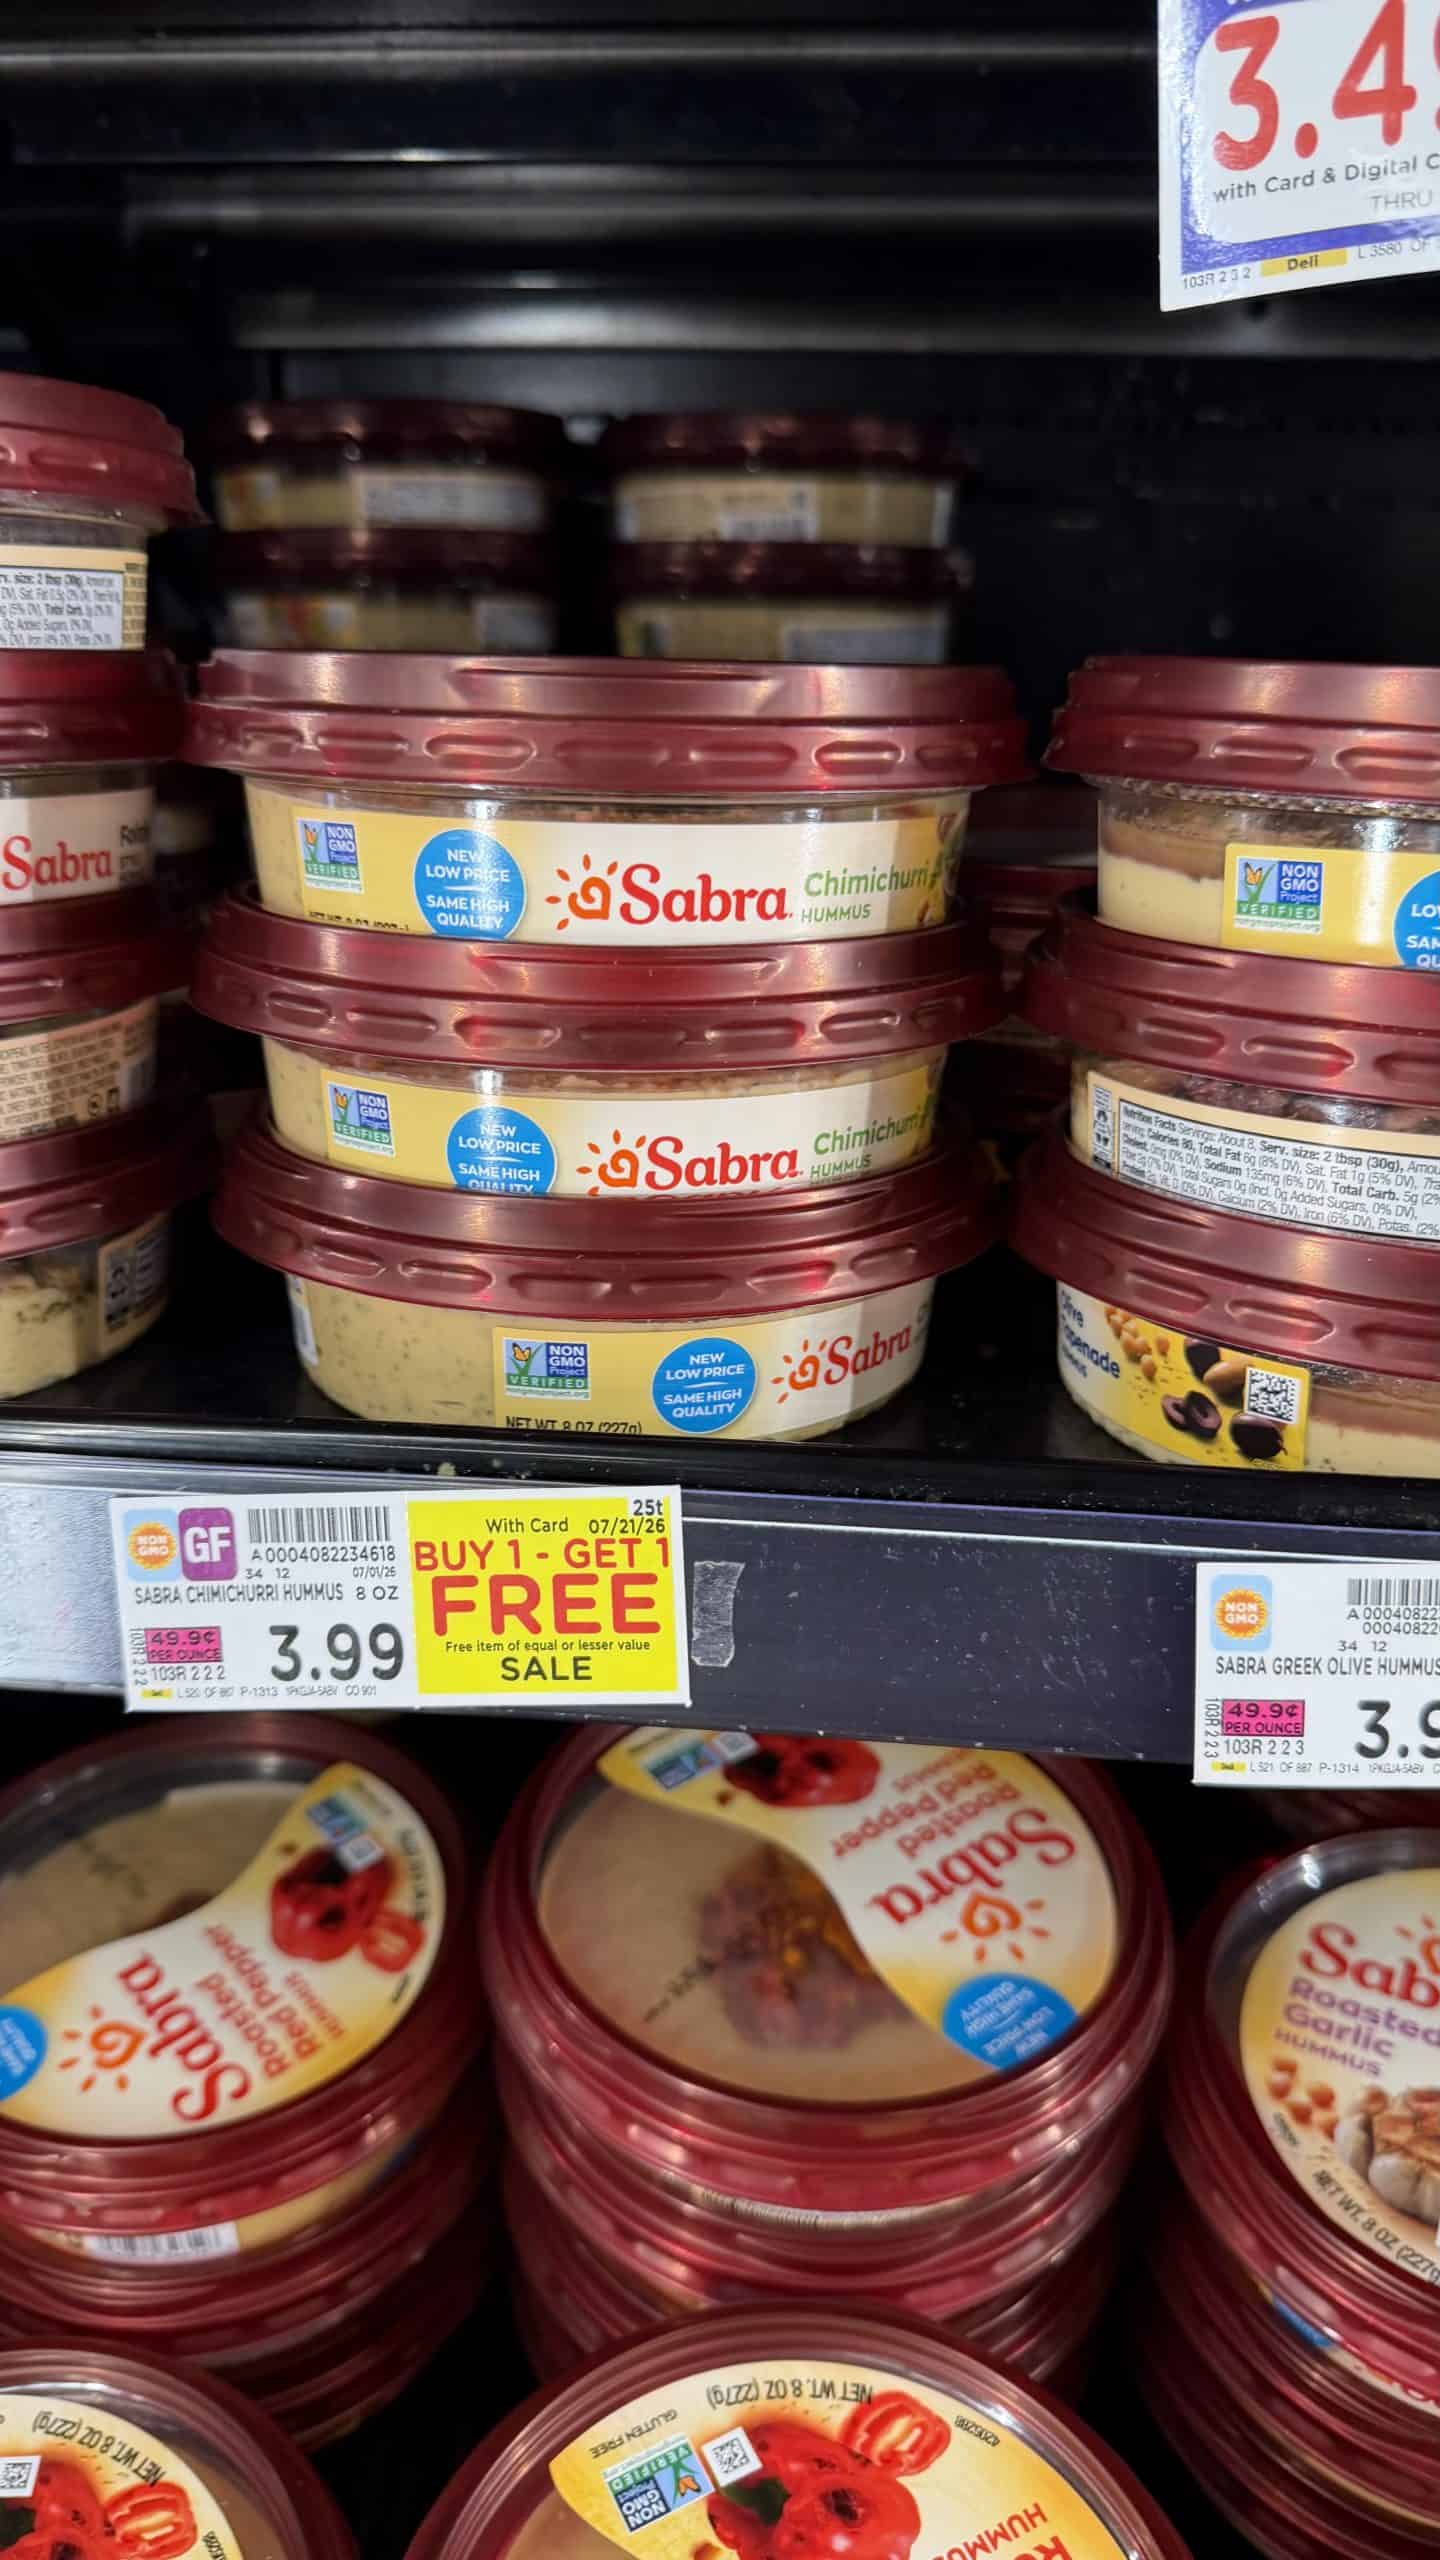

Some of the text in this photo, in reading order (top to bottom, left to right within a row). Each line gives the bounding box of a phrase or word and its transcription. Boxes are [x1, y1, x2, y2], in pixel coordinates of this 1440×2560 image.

[1213, 0, 1440, 172] 3.4
[1213, 180, 1256, 203] with
[1265, 171, 1314, 193] Card
[1322, 168, 1336, 184] &
[1345, 156, 1417, 181] Digital
[1370, 190, 1433, 211] THRU
[327, 826, 354, 840] NON
[328, 839, 355, 852] GMO
[2, 835, 112, 890] Sabra
[447, 849, 483, 863] NEW
[426, 865, 510, 883] LOW PRICE
[1281, 863, 1319, 878] NON
[619, 863, 790, 925] Sabra
[1280, 878, 1320, 892] GMO
[426, 895, 509, 914] SAME HIGH
[801, 904, 871, 923] HUMMUS
[1240, 904, 1318, 920] VERIFIED
[436, 913, 503, 929] QUALITY
[359, 1094, 386, 1108] NON
[360, 1105, 387, 1120] GMO
[481, 1124, 516, 1137] NEW
[458, 1136, 541, 1155] LOW PRICE
[1198, 1143, 1222, 1157] Total
[1225, 1148, 1241, 1161] Fat
[645, 1136, 800, 1190] Sabra
[811, 1154, 872, 1178] HUMMUS
[1324, 1152, 1332, 1162] 2
[1336, 1152, 1362, 1167] tbsp
[458, 1164, 540, 1181] SAME HIGH
[1204, 1158, 1362, 1197] Sodium Total
[549, 1345, 585, 1356] NON
[689, 1352, 725, 1365] NEW
[550, 1356, 585, 1367] GMO
[509, 1375, 585, 1388] VERIFIED
[665, 1364, 745, 1381] LOW PRICE
[664, 1388, 742, 1404] SAME HIGH
[672, 1402, 736, 1418] QUALITY
[633, 1499, 664, 1516] 25t
[486, 1517, 568, 1533] With Card
[588, 1518, 665, 1535] 07/21/26
[184, 1526, 232, 1564] GF
[414, 1540, 494, 1571] BUY
[508, 1539, 521, 1569] 1
[564, 1538, 642, 1569] GET
[655, 1537, 669, 1568] 1
[276, 1568, 290, 1579] 12
[135, 1583, 399, 1605] SABRA CHIMICHURRI HUMMUS 8 OZ
[432, 1572, 661, 1637] FREE
[1225, 1602, 1258, 1613] NON
[1225, 1613, 1259, 1625] GMO
[151, 1630, 216, 1646] 49.9¢
[445, 1640, 650, 1654] Free item of equal or lesser value
[1338, 1640, 1387, 1652] 34 12
[269, 1622, 404, 1682] 3.99
[191, 1665, 225, 1680] 2 2 2
[501, 1656, 592, 1681] SALE
[1216, 1657, 1267, 1675] SABRA
[1272, 1657, 1322, 1675] GREEK
[1328, 1657, 1372, 1675] OLIVE
[1228, 1702, 1298, 1718] 49.9¢
[1225, 1722, 1301, 1734] PER OUNCE
[1224, 1739, 1304, 1755] 103R 2 2 3
[1319, 1763, 1360, 1774] P-1314
[831, 1792, 939, 1857] Pepper
[898, 1782, 1020, 1858] Roasted
[871, 1808, 1075, 1925] Sabra
[204, 1924, 323, 2061] Red Pepper
[196, 1972, 291, 2079] Roasted
[1284, 2003, 1394, 2058] Garlic
[118, 1952, 252, 2123] Sabra
[1273, 2028, 1381, 2076] HUMMUS
[1312, 2169, 1343, 2196] NET
[1361, 2217, 1377, 2232] 8
[1374, 2227, 1400, 2249] OZ
[706, 2379, 873, 2410] NET WT. 8 OZ (227g)
[623, 2408, 678, 2443] GLUTEN
[77, 2426, 103, 2449] OZ
[101, 2435, 114, 2453] 8
[590, 2437, 624, 2459] FREE
[137, 2459, 167, 2487] NET
[610, 2445, 693, 2491] VERIFIED
[622, 2490, 662, 2515] GMO
[629, 2504, 667, 2532] NON
